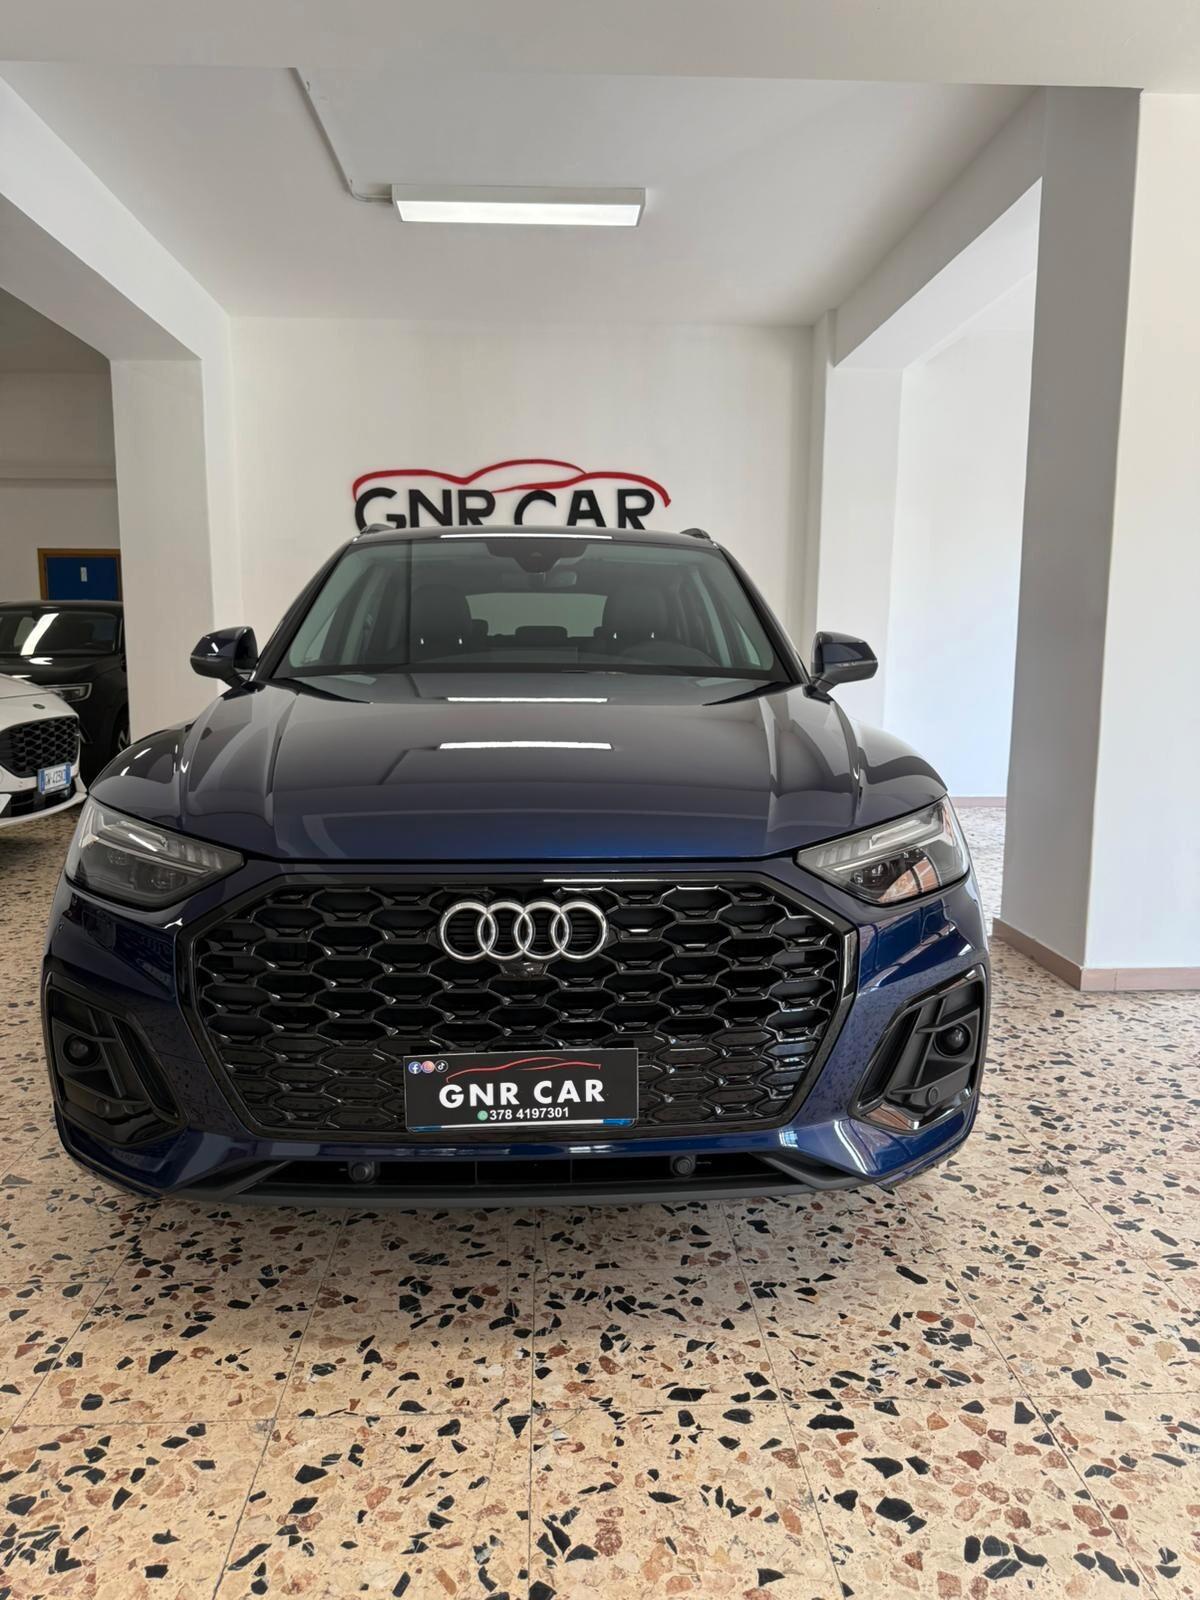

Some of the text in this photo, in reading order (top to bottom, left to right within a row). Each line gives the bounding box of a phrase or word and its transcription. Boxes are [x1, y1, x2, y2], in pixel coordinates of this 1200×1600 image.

[355, 487, 655, 531] GNR CAR
[439, 1079, 605, 1109] GNR CAR
[489, 1107, 570, 1121] 378 4197301
